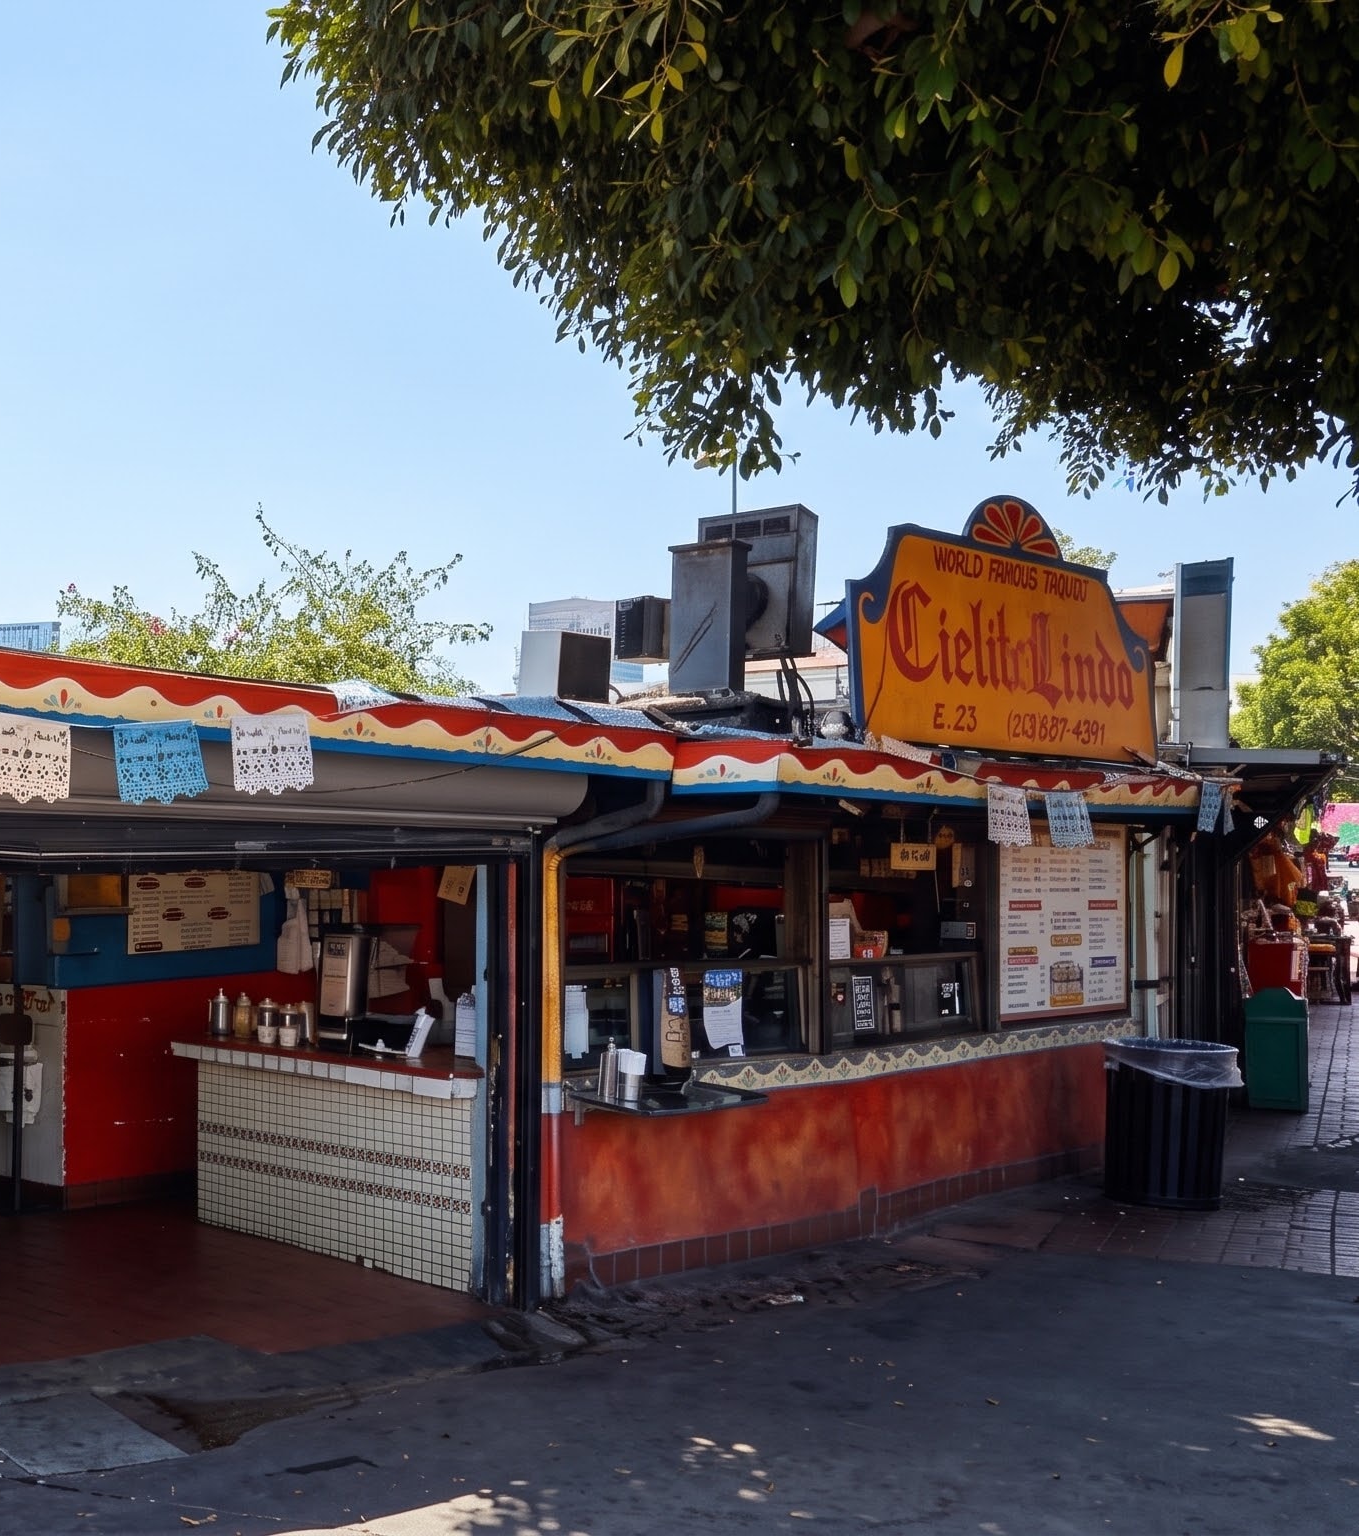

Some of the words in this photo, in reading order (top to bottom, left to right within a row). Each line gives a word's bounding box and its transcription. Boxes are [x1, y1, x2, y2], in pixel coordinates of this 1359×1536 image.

[933, 545, 983, 579] WORLD
[988, 559, 1038, 590] FAMOUS
[1027, 612, 1135, 710] Lindo
